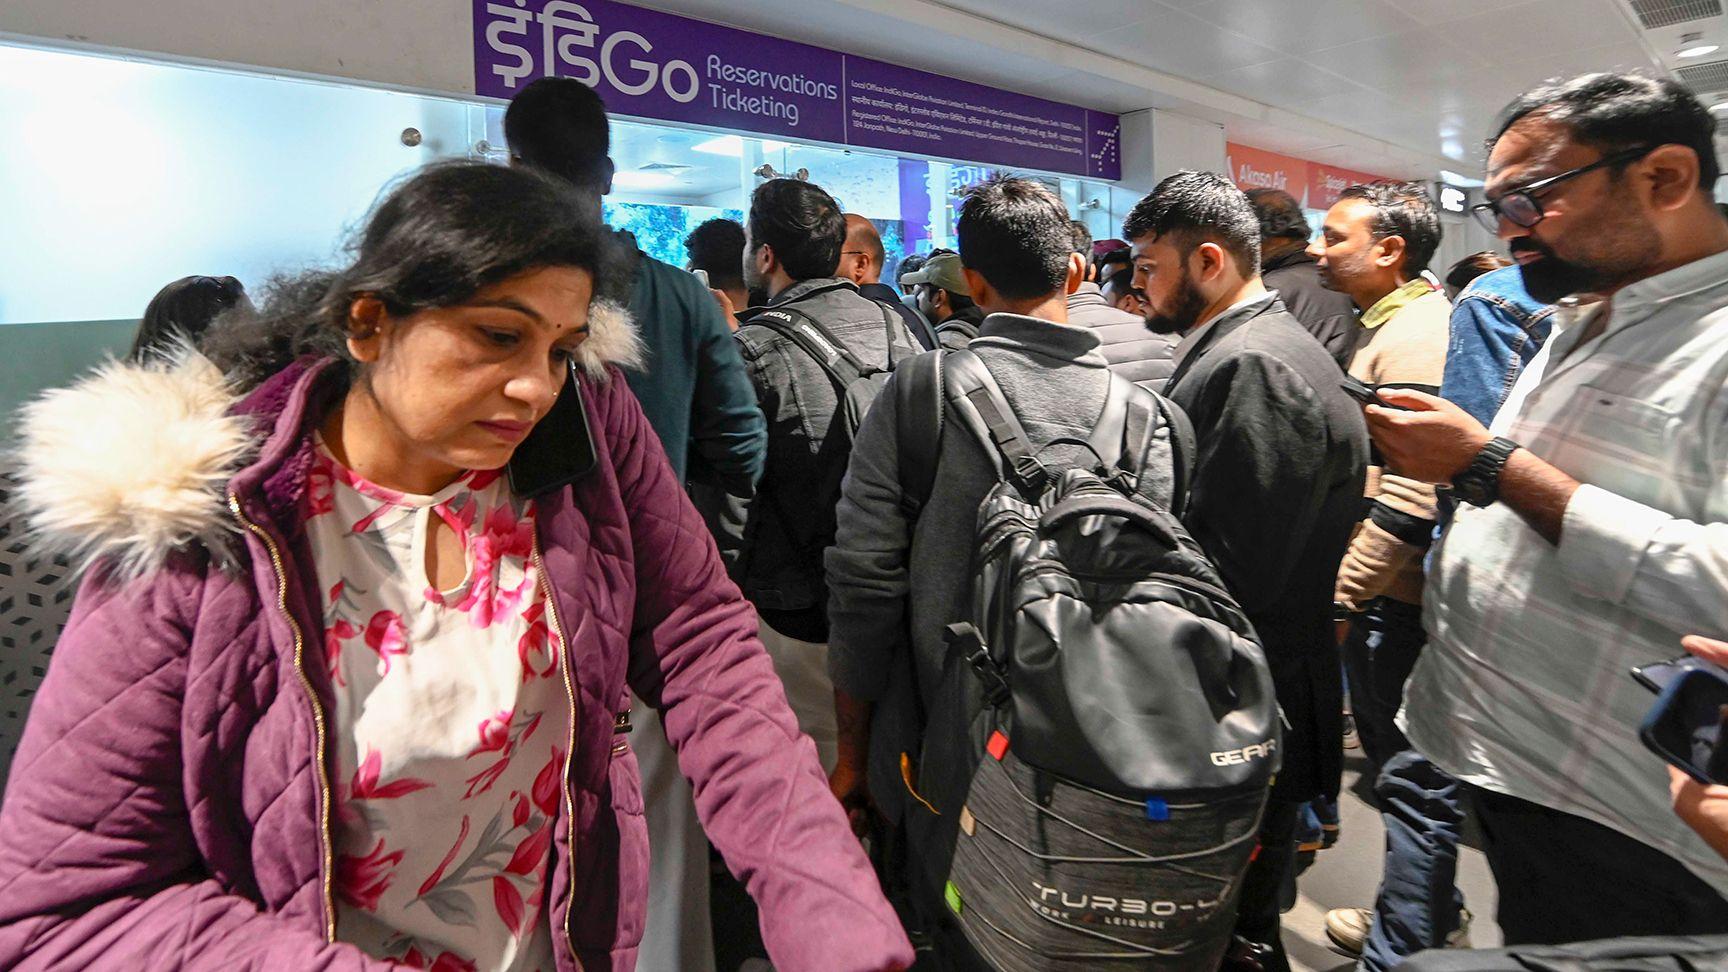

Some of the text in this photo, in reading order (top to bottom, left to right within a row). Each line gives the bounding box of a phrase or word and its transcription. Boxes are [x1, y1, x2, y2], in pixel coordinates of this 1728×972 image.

[707, 54, 838, 100] Reservations
[708, 83, 799, 126] Ticketing
[1239, 164, 1287, 190] Akasa Air
[1210, 739, 1276, 767] GEAR
[1104, 916, 1165, 929] LEISURE
